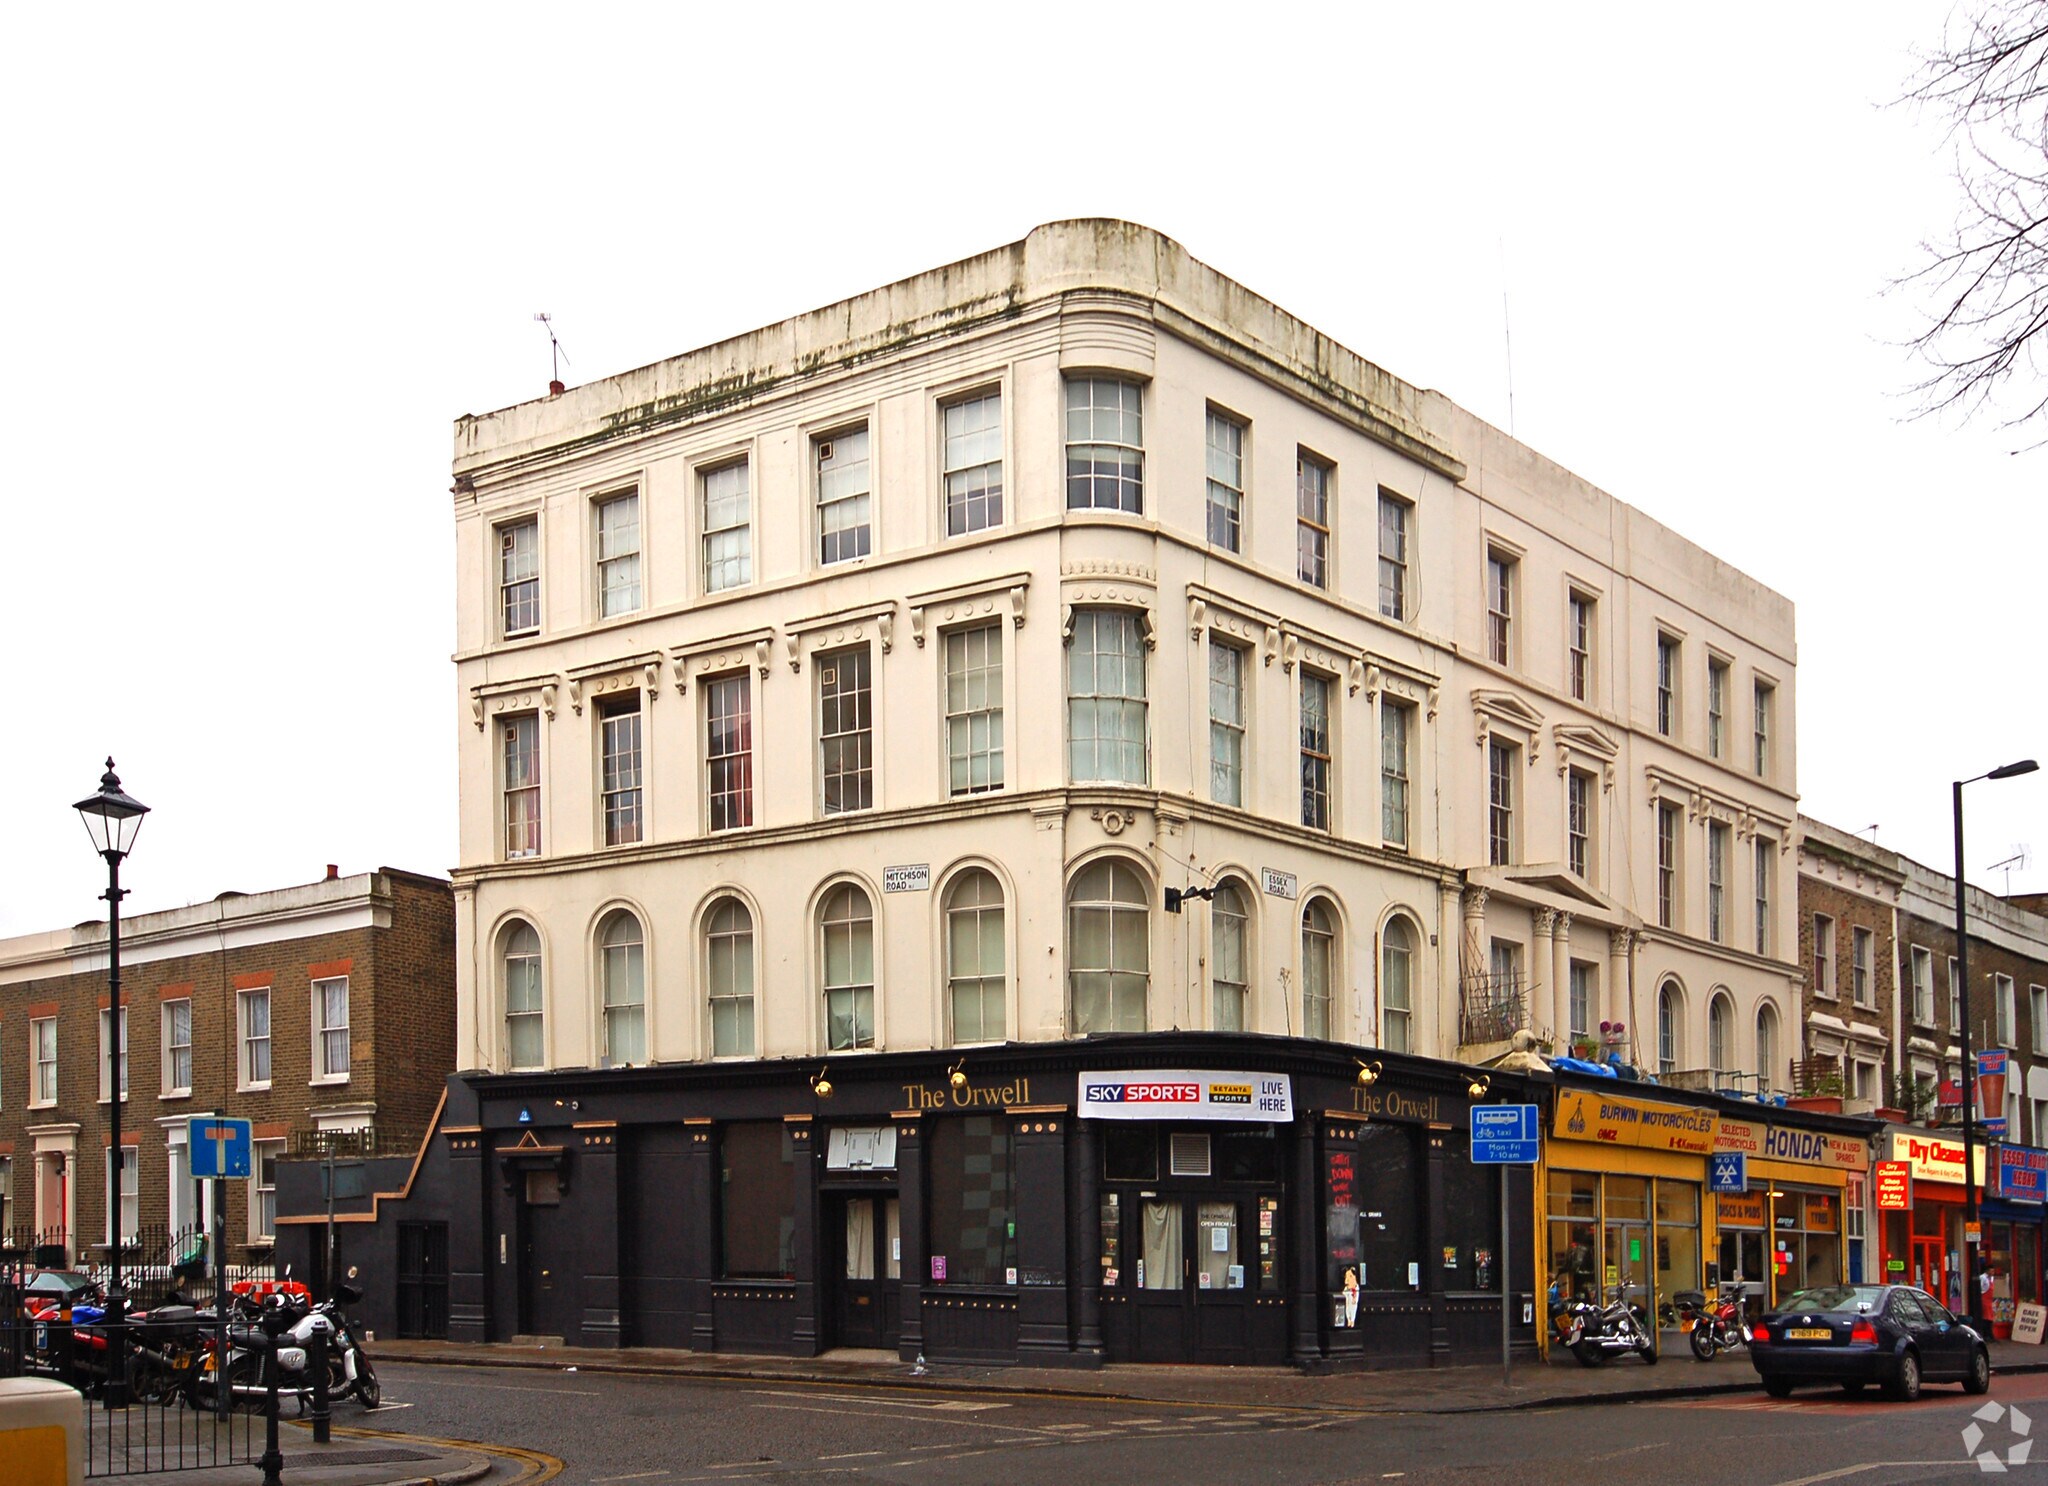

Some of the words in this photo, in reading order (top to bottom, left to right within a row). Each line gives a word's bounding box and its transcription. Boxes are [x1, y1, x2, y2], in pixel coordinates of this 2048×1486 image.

[886, 870, 927, 881] MITCHISON
[1269, 874, 1288, 887] ESSEX
[886, 881, 907, 890] ROAD
[1269, 884, 1285, 896] ROAD
[903, 1084, 944, 1108] The
[952, 1078, 1031, 1107] Orwell
[1088, 1086, 1122, 1100] SKY
[1126, 1085, 1197, 1100] SPORTS
[1261, 1081, 1283, 1095] LIVE
[1259, 1098, 1286, 1112] HERE
[1350, 1086, 1381, 1113] The
[1386, 1091, 1438, 1119] Orwell
[1600, 1104, 1638, 1124] BURWIN
[1642, 1111, 1711, 1133] MOTORCYCLES
[1721, 1123, 1751, 1137] SELECTED
[1714, 1136, 1757, 1151] MOTORCYCLES
[1765, 1127, 1822, 1161] HONDA
[1829, 1140, 1841, 1150] NEW
[1848, 1143, 1861, 1153] USED
[1835, 1152, 1856, 1163] SPARES
[1909, 1139, 1929, 1164] Dry
[2001, 1149, 2025, 1167] ESSEX
[2028, 1152, 2046, 1170] ROAD
[2012, 1169, 2037, 1187] KEBAB
[1880, 1199, 1904, 1207] Cutting
